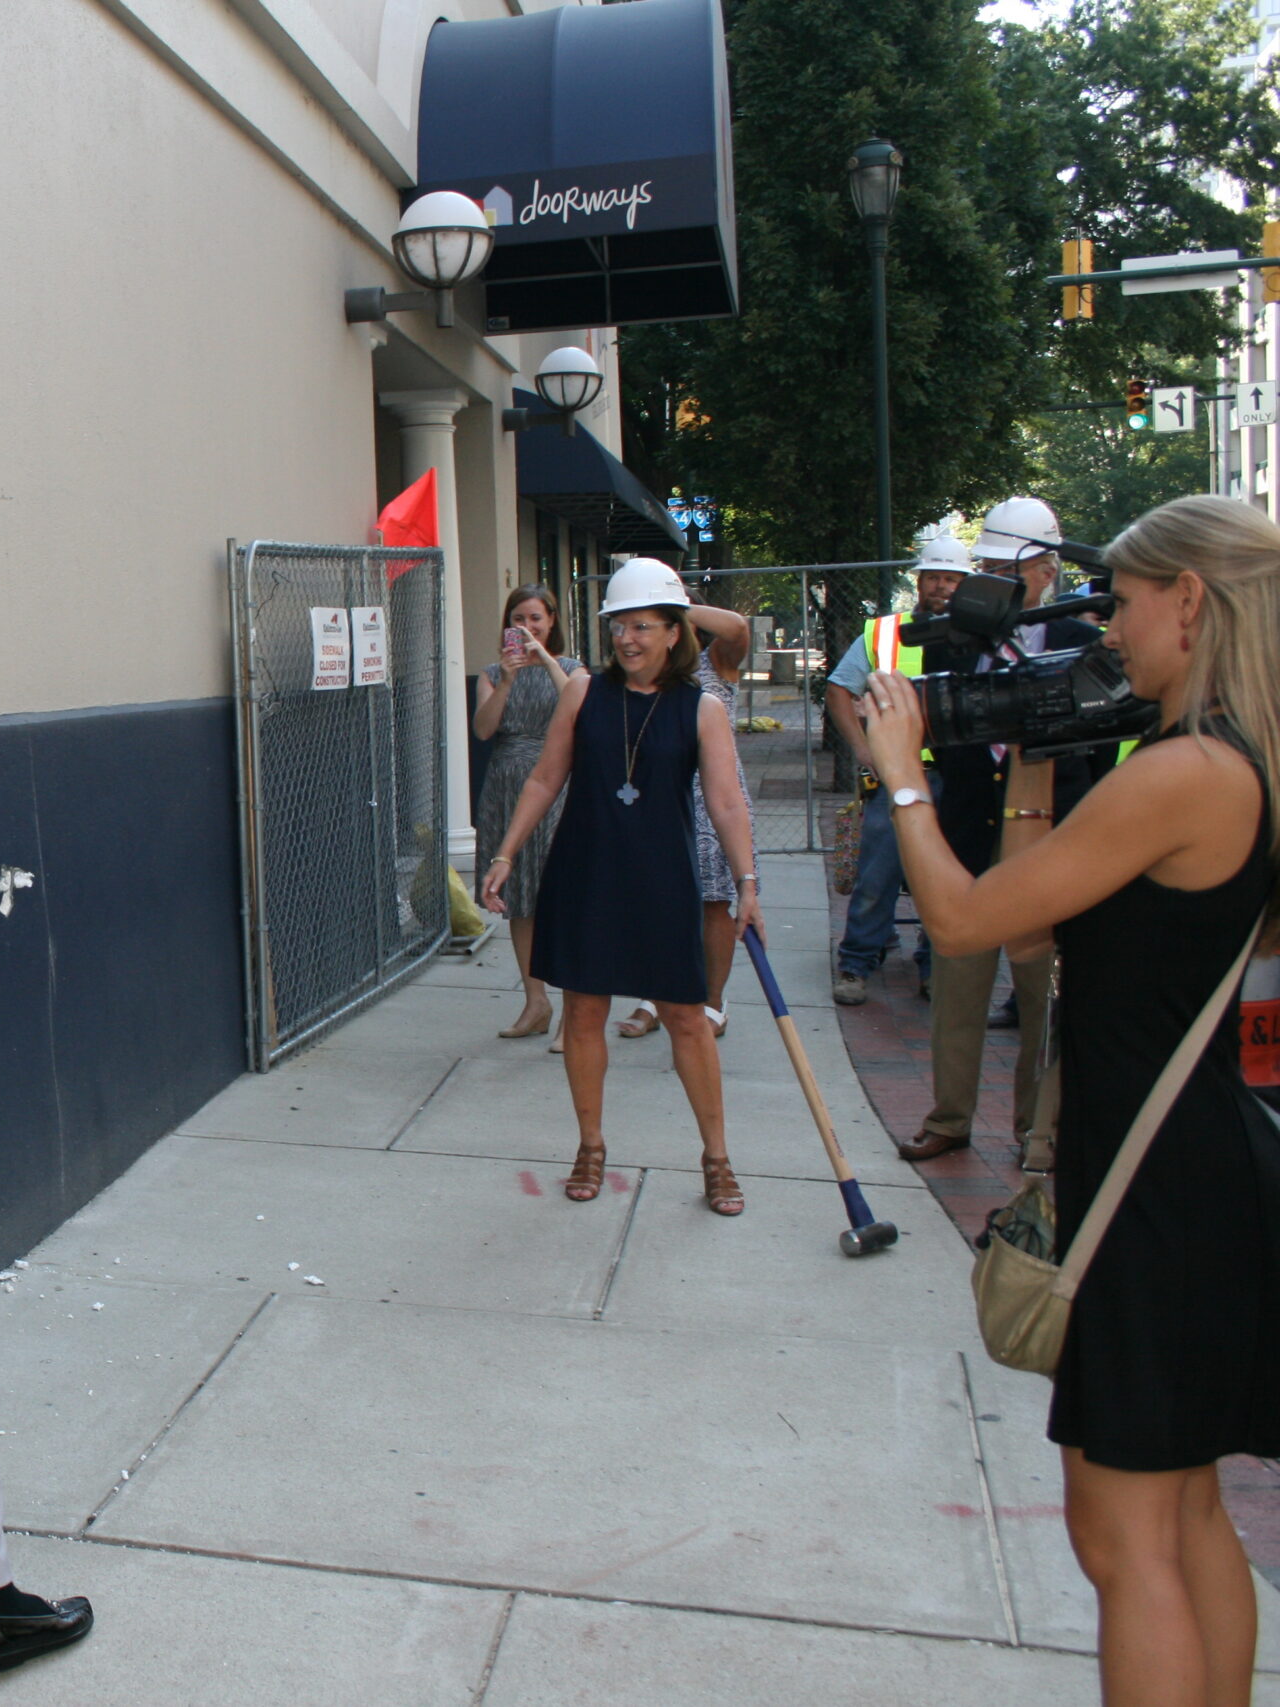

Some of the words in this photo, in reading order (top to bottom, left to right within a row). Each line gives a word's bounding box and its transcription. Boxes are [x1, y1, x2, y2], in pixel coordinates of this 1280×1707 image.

[519, 179, 653, 230] doorways
[1242, 411, 1273, 423] ONLY
[319, 661, 337, 671] CLOSED
[315, 675, 348, 686] CONSTRUCTION
